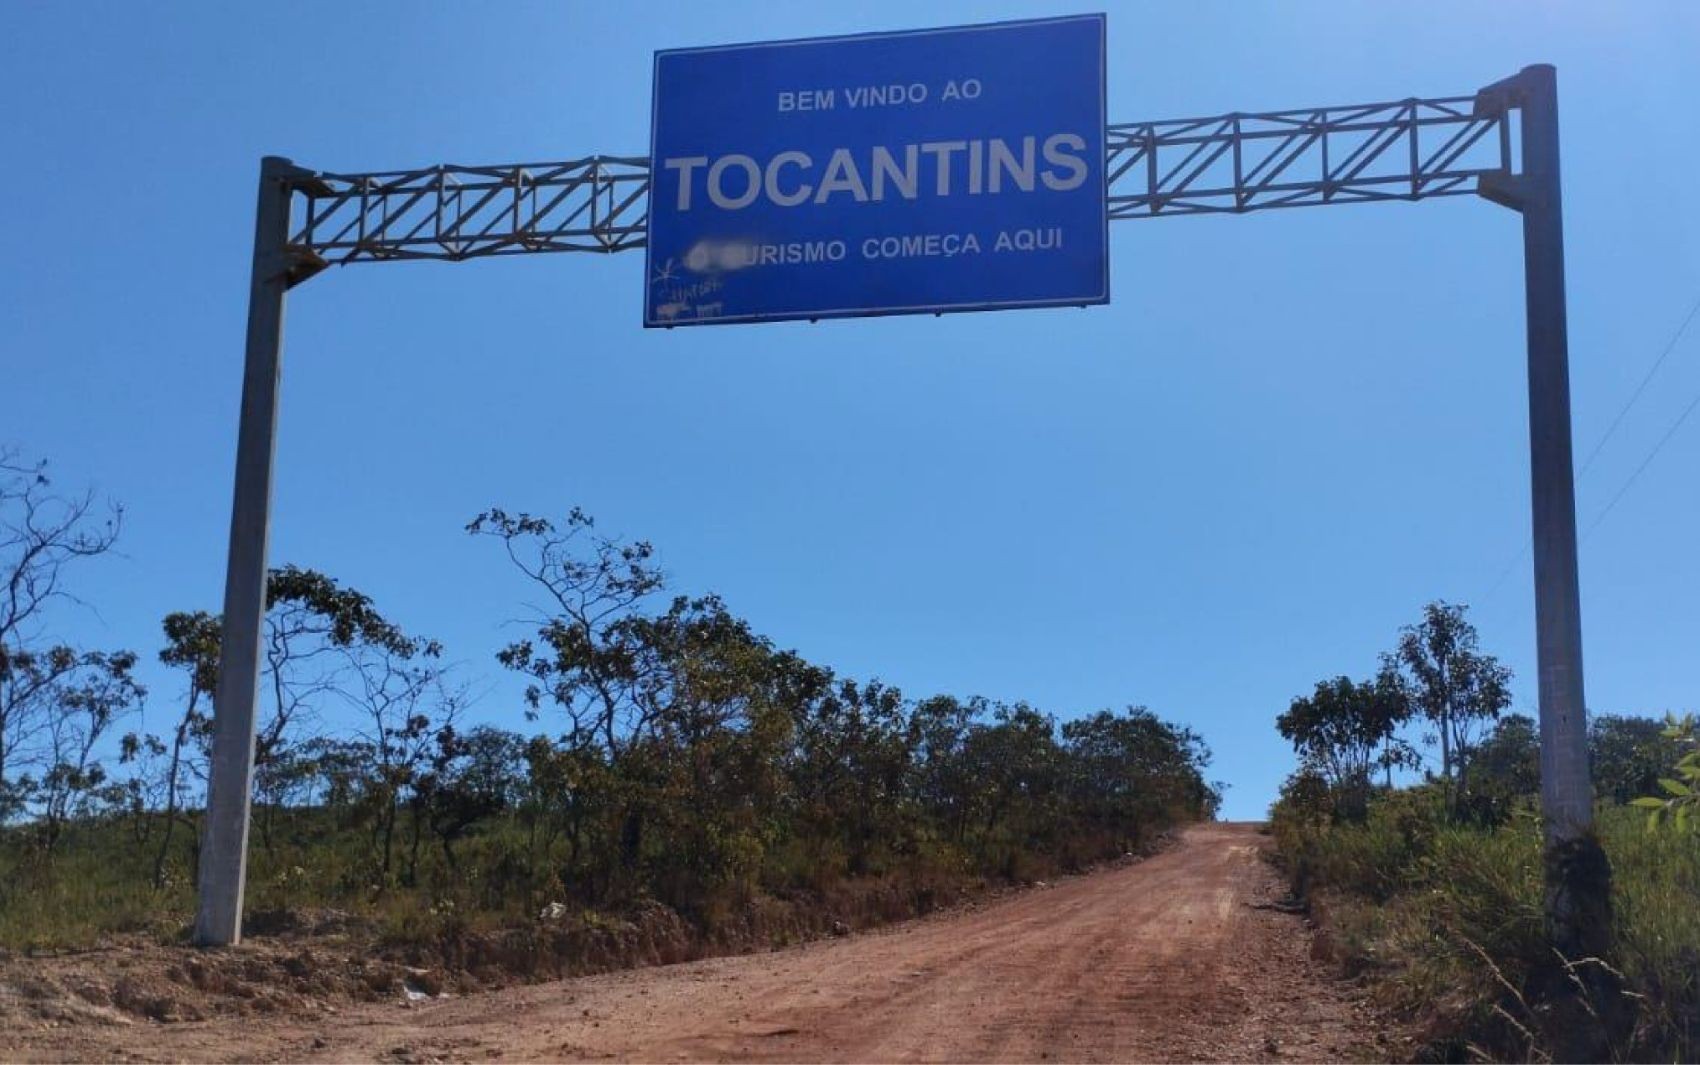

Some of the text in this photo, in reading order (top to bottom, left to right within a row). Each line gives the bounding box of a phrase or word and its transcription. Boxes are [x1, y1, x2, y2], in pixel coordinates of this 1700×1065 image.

[778, 79, 982, 112] BEM VINDO AO
[664, 133, 1089, 211] TOCANTINS
[724, 241, 847, 267] URISMO
[862, 228, 981, 258] COMEÇA
[994, 227, 1063, 252] AQUI
